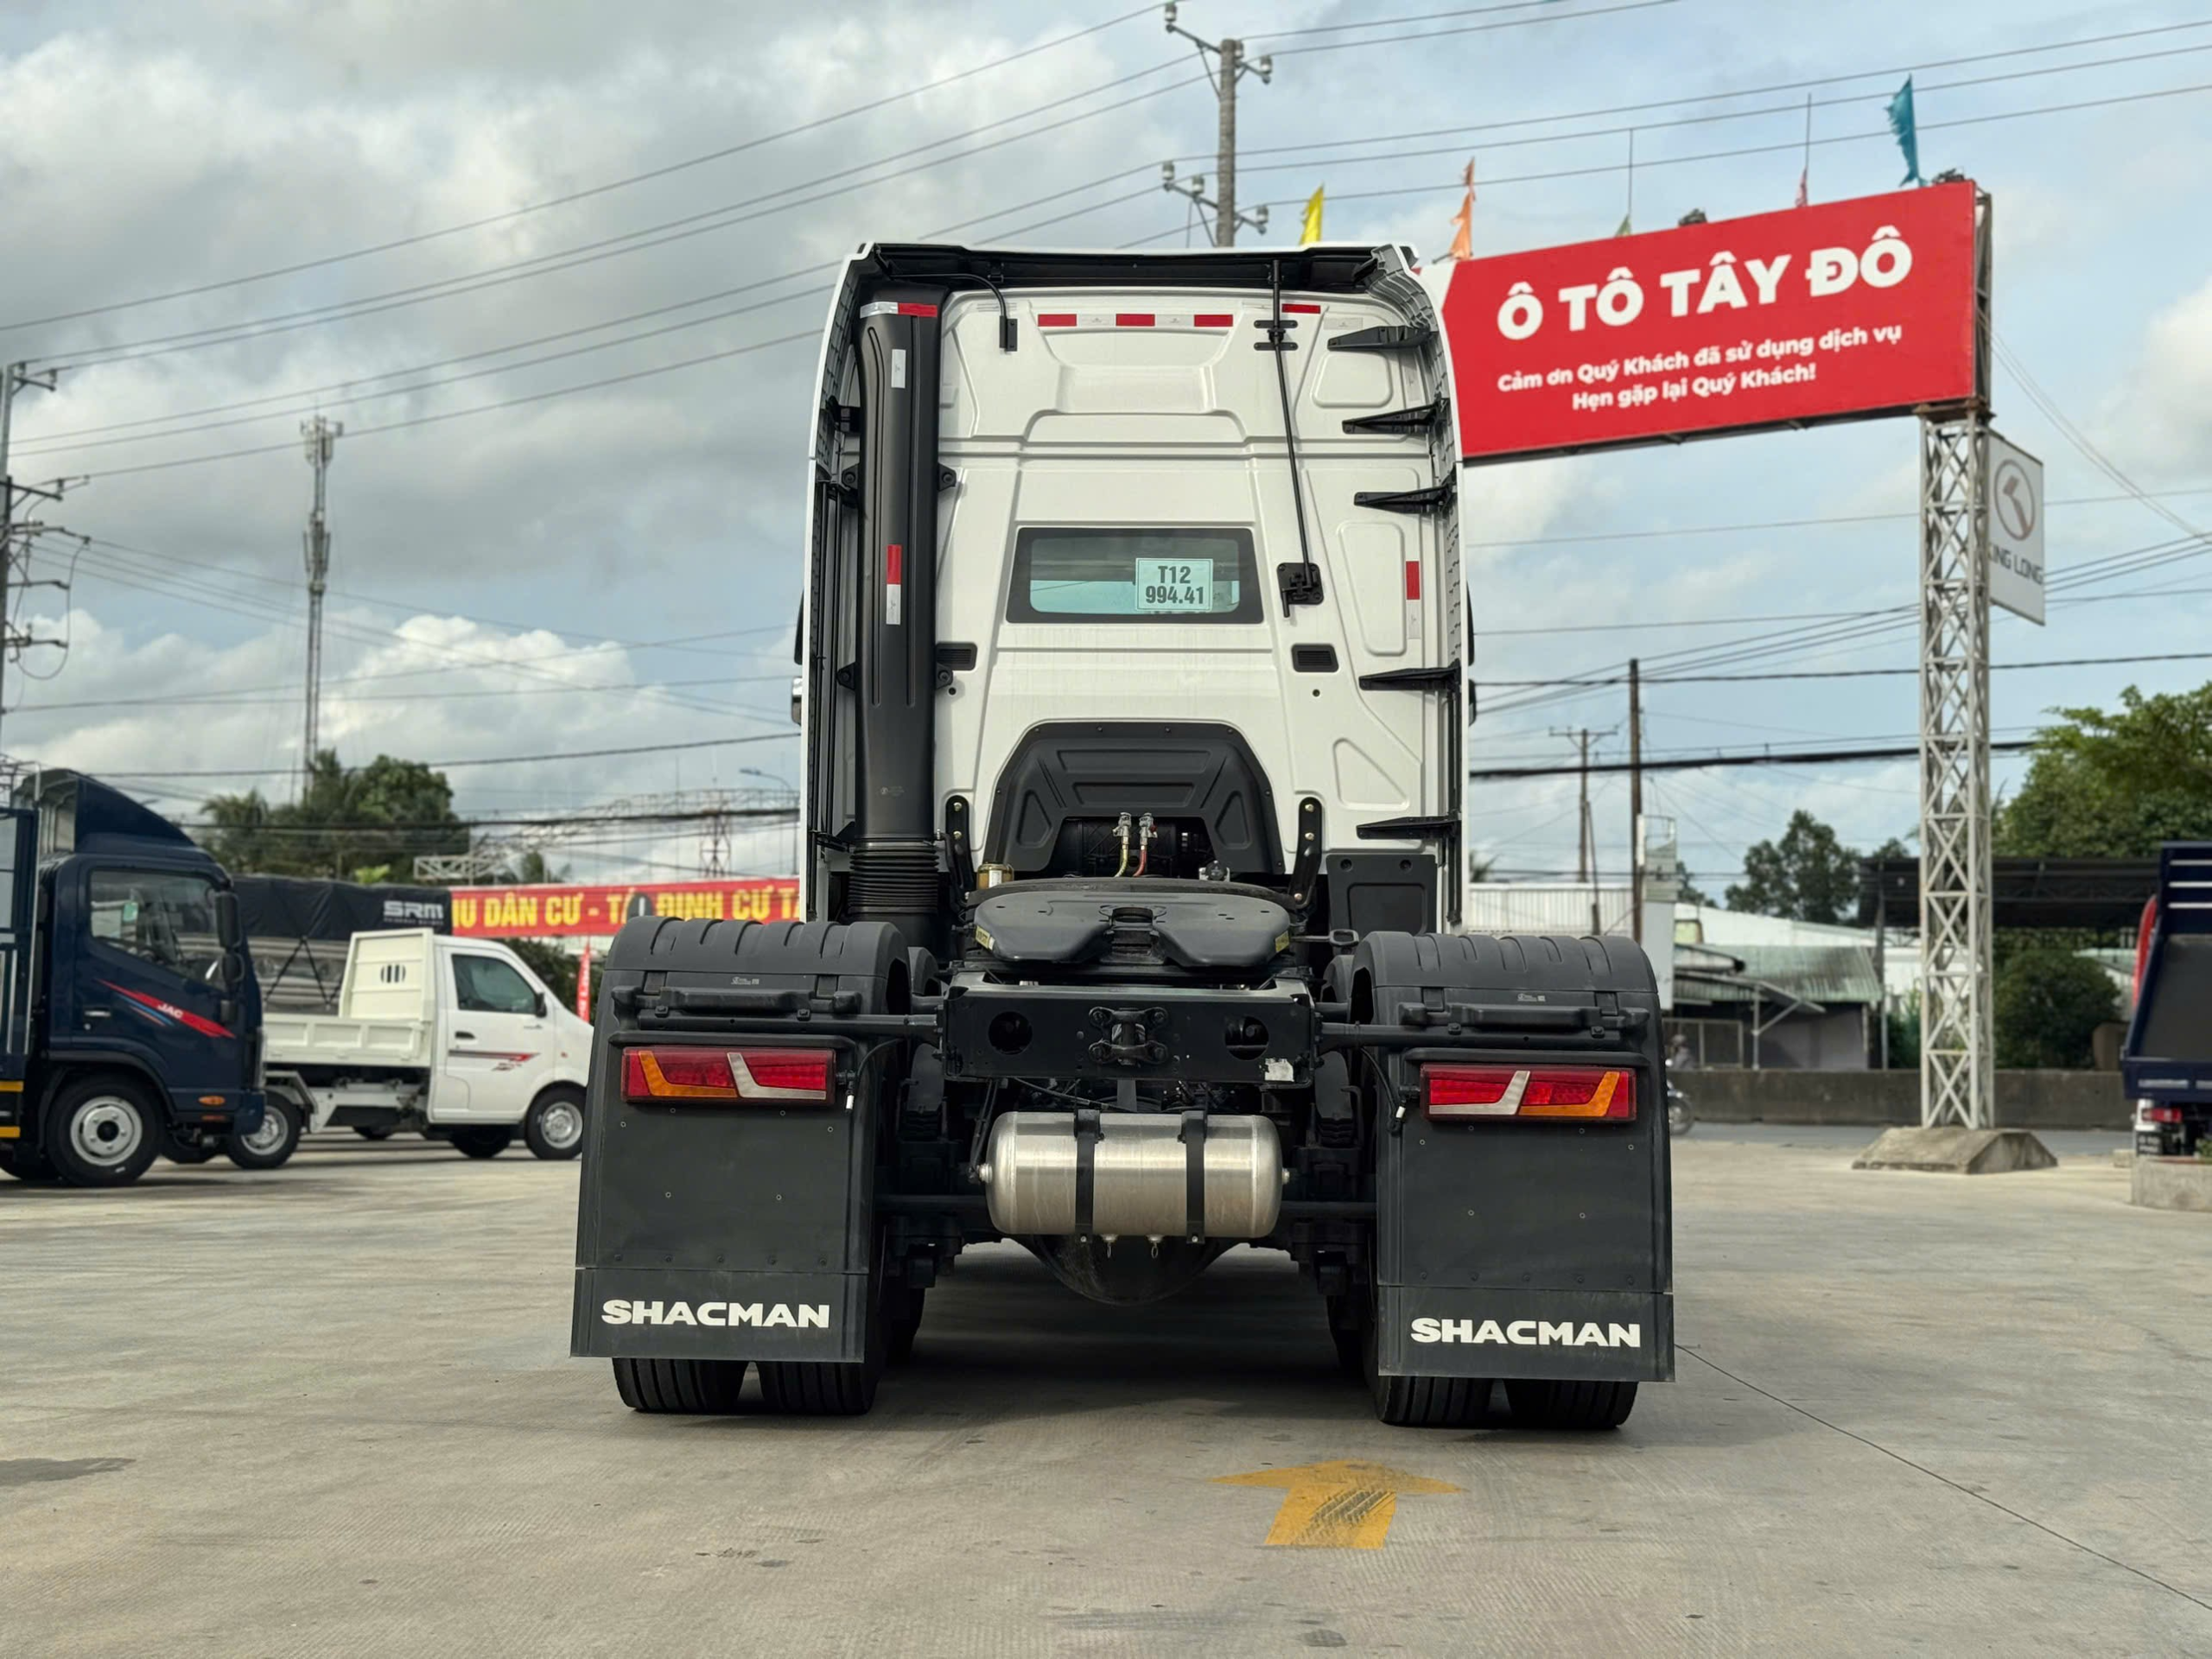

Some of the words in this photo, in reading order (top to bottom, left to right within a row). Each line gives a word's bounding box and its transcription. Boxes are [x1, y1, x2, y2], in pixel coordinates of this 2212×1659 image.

[1497, 282, 1543, 340] Ô
[1559, 267, 1643, 332] TÔ
[1660, 251, 1792, 317] TÂY
[1805, 226, 1913, 296] ĐÔ
[1497, 370, 1542, 392] Cảm
[1577, 359, 1620, 385] Quý
[1624, 351, 1690, 376] Khách
[1694, 346, 1721, 366] đã
[1725, 340, 1753, 362] sử
[1756, 337, 1814, 360] dụng
[1818, 327, 1868, 352] dịch
[1872, 325, 1903, 345] vụ
[1573, 391, 1613, 411] Hẹn
[1618, 385, 1658, 408] gặp
[1662, 378, 1688, 402] lại
[1692, 372, 1737, 397] Quý
[1740, 363, 1816, 389] Khách!
[1157, 565, 1191, 583] T12
[1988, 543, 2012, 569] ING
[2013, 554, 2044, 586] LONG
[1145, 585, 1205, 605] 994.41
[384, 899, 444, 919] SRM
[484, 891, 537, 928] DÂN
[544, 892, 585, 926] CƯ
[588, 906, 601, 917] -
[732, 884, 775, 921] CƯ
[779, 887, 800, 919] T
[157, 1002, 184, 1019] JAC
[601, 1299, 830, 1329] SHACMAN
[1410, 1317, 1642, 1348] SHACMAN
